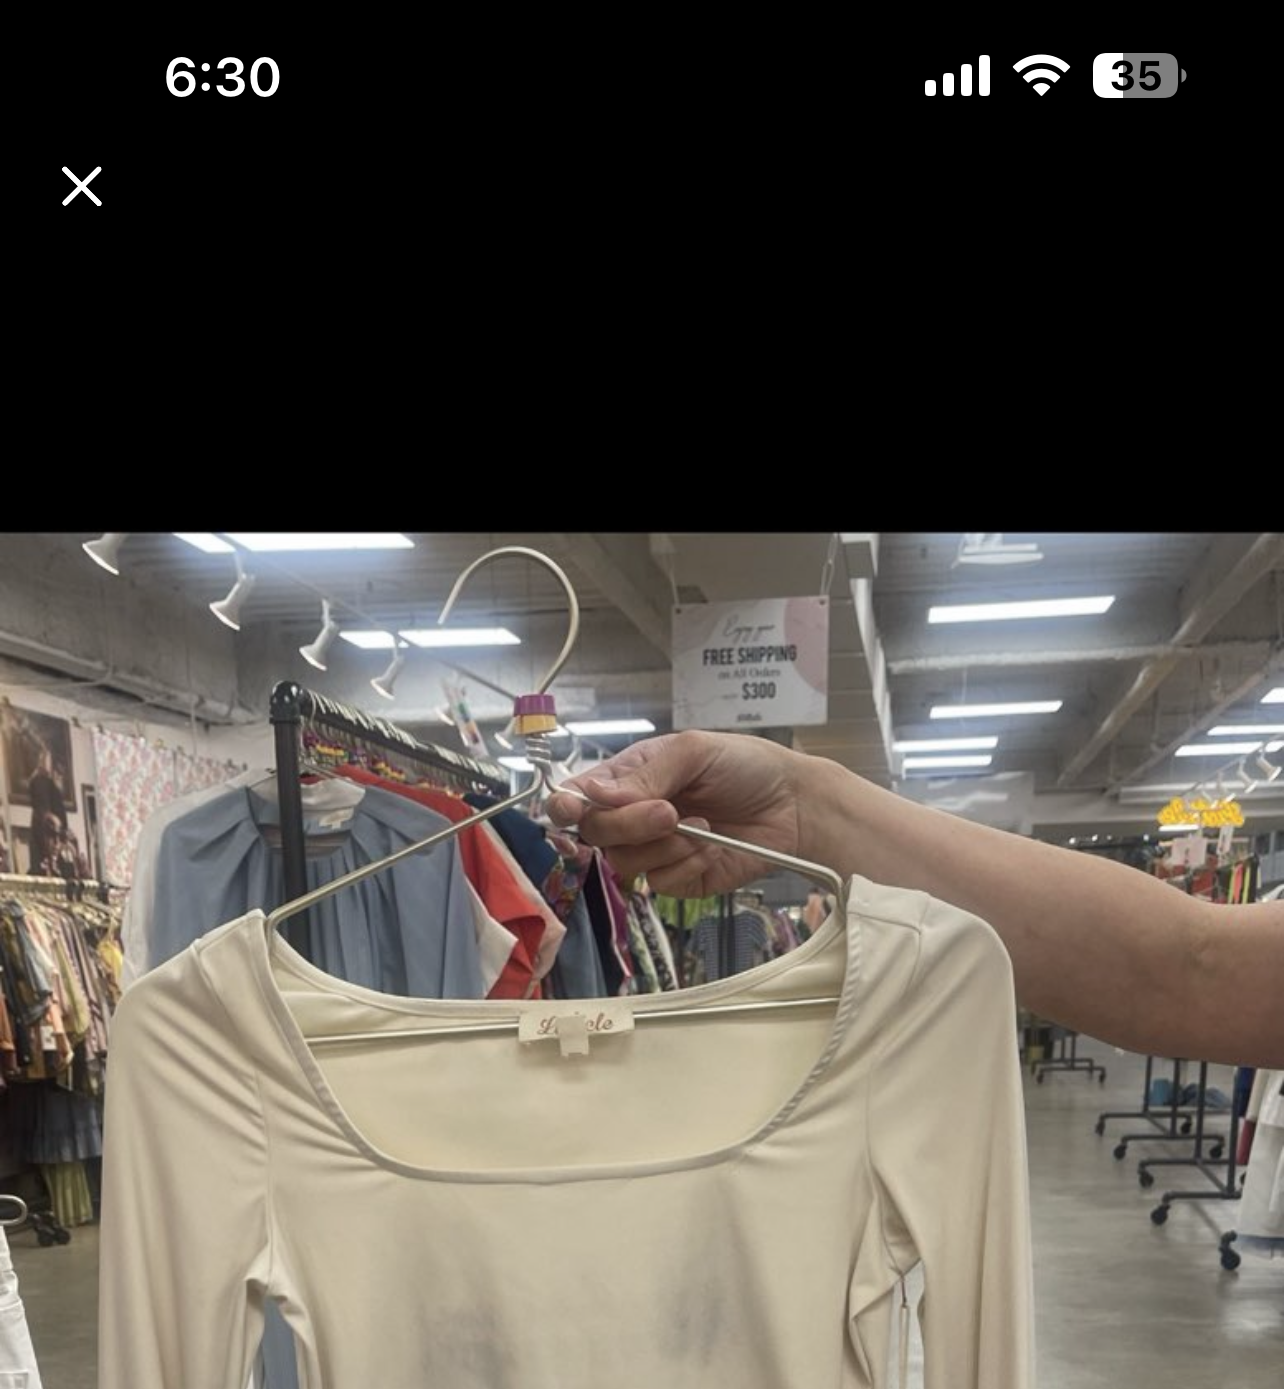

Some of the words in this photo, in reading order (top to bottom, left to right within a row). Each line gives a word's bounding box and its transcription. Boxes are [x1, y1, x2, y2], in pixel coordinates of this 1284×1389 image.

[703, 648, 734, 666] FREE
[738, 644, 797, 663] SHIPPING
[742, 682, 776, 700] $300
